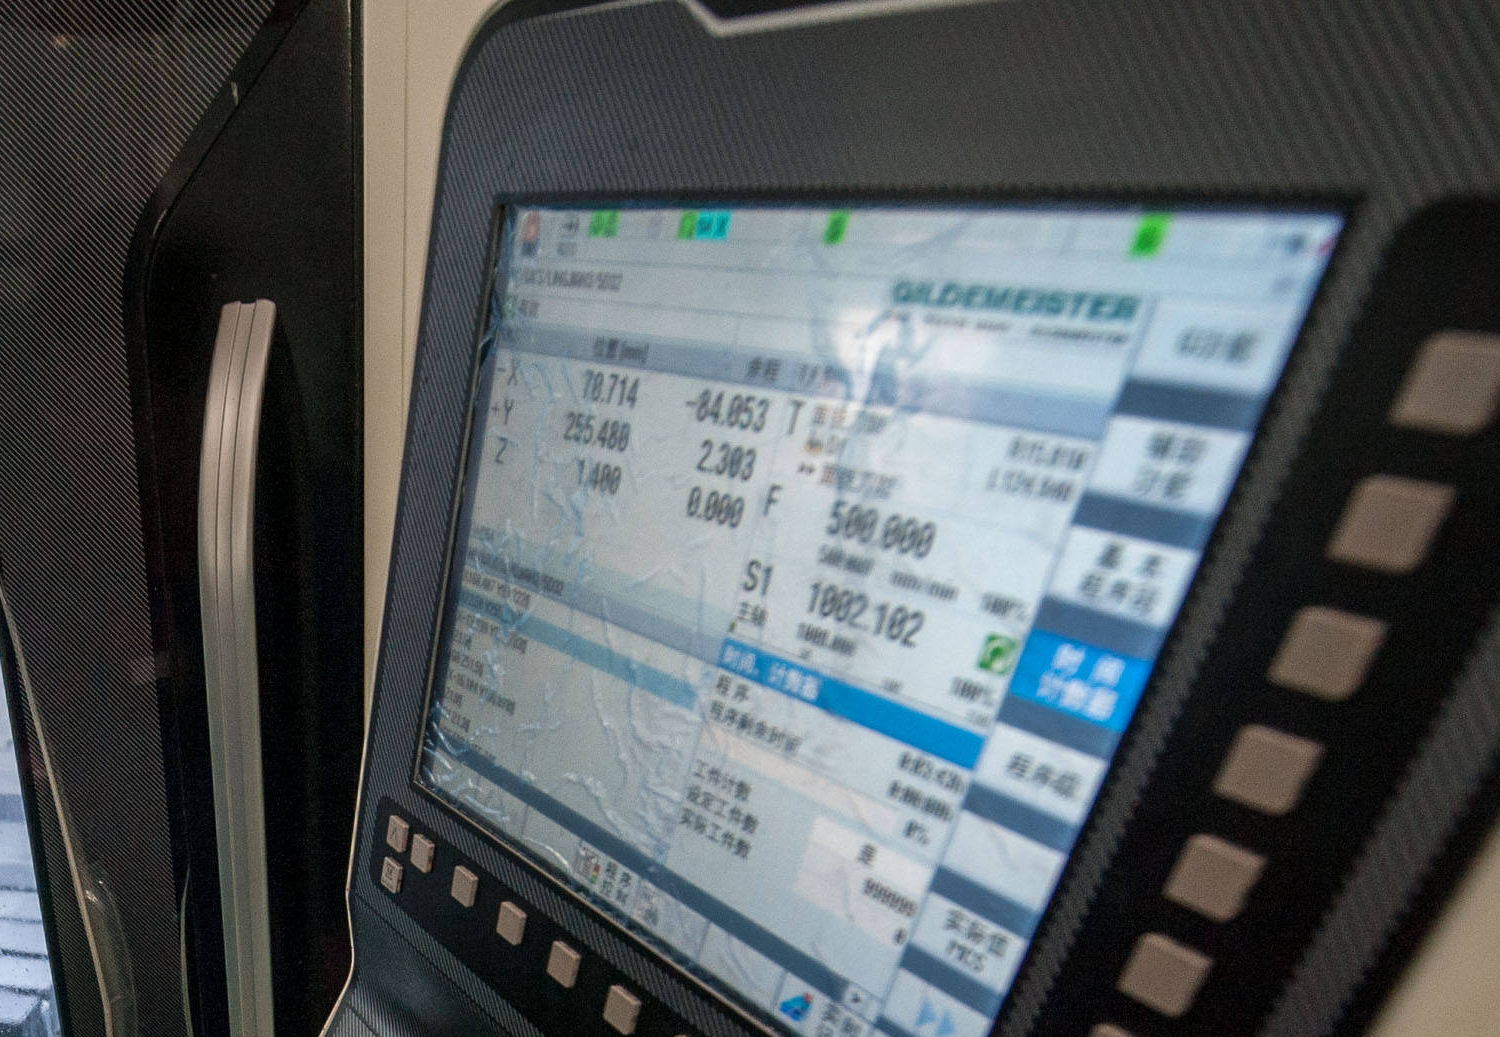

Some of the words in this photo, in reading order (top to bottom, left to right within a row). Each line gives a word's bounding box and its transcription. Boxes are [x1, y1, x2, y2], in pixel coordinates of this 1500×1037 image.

[891, 279, 1139, 322] GILDEMEISTER
[786, 400, 805, 436] T
[494, 436, 508, 465] Z
[687, 486, 745, 528] 0.000
[762, 484, 783, 517] F
[826, 499, 937, 559] 500.000
[741, 558, 774, 597] S1
[807, 580, 926, 648] 1002.102
[692, 758, 751, 802] 工件计数
[679, 807, 751, 861] 实际工件数
